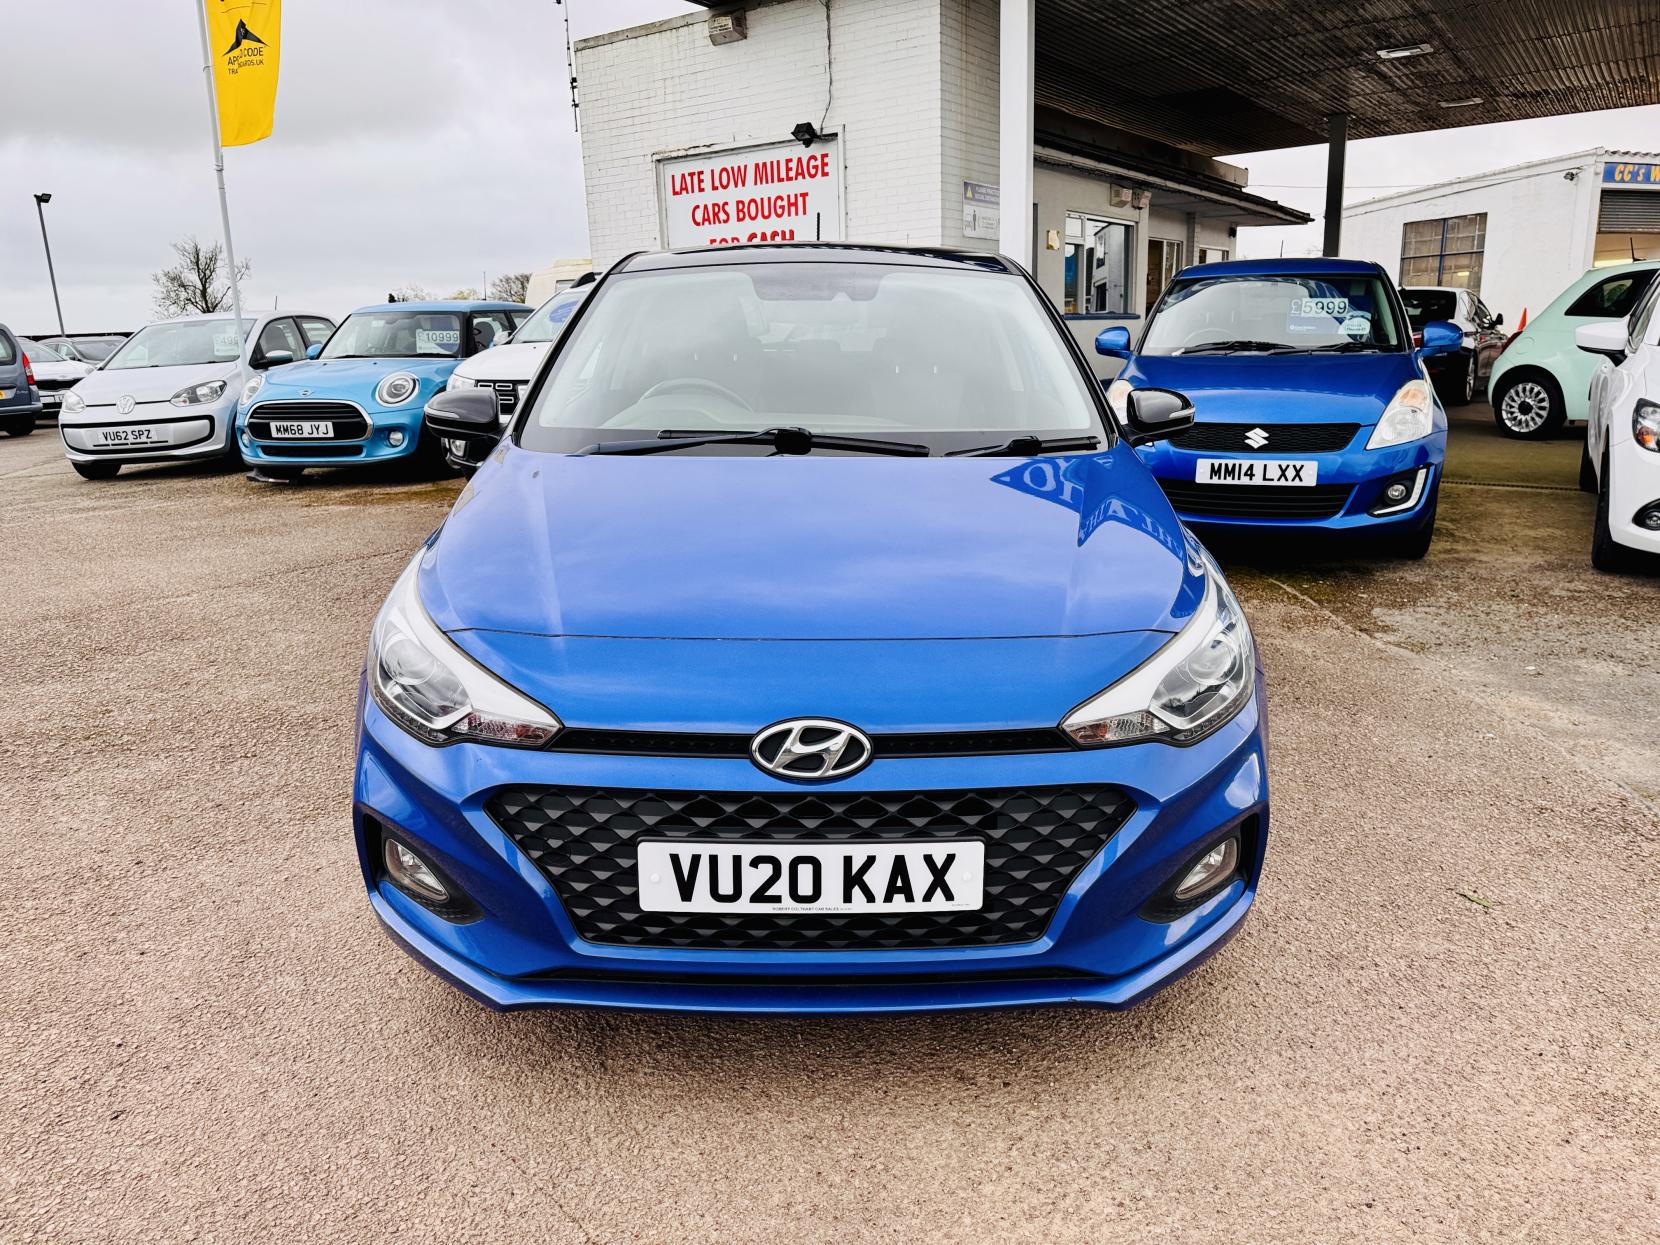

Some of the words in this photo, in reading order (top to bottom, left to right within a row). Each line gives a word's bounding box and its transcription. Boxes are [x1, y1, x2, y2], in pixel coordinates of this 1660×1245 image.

[671, 170, 705, 196] LATE
[710, 164, 748, 192] LOW
[753, 153, 829, 186] MILEAGE
[691, 201, 730, 227] CARS
[736, 192, 809, 223] BOUGHT
[102, 430, 129, 441] VU62
[130, 429, 152, 440] SPZ
[275, 424, 304, 436] MM68
[307, 423, 329, 436] JYJ
[1209, 462, 1255, 481] MM14
[1262, 464, 1304, 483] LXX
[669, 853, 822, 904] VU20
[843, 853, 957, 904] KAX
